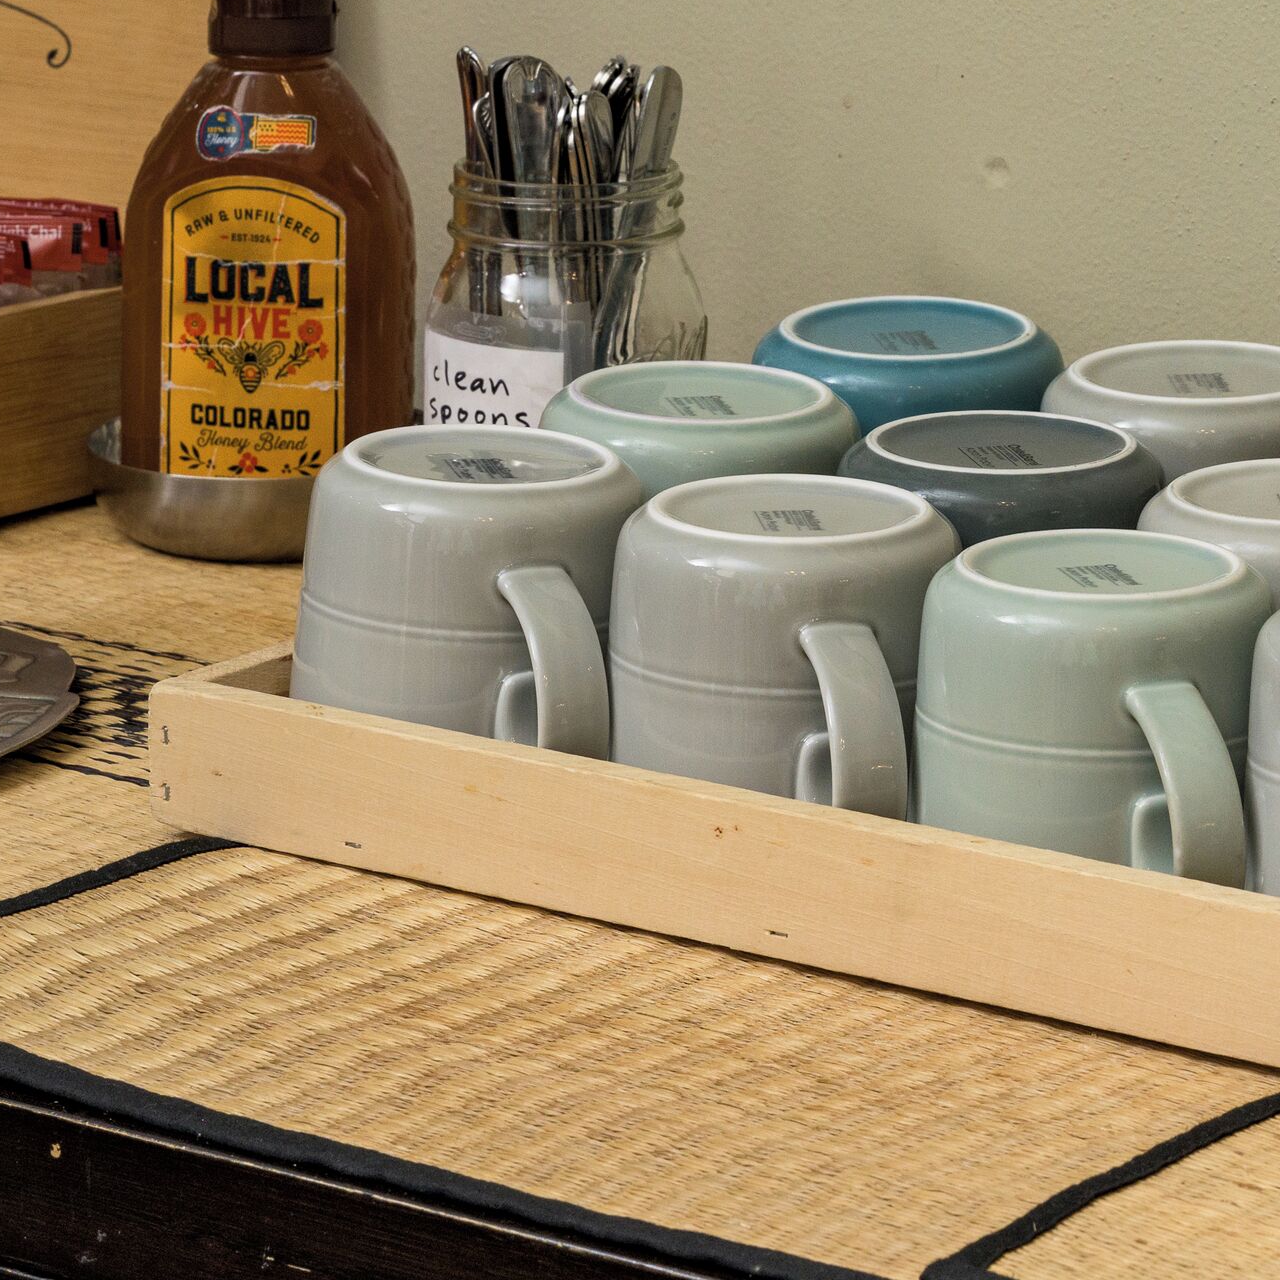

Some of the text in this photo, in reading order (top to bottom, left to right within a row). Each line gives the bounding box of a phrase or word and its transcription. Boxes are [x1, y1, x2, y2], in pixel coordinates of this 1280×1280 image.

[28, 224, 63, 240] Chai
[184, 208, 321, 245] RAW & UNFILTERED
[185, 256, 324, 309] LOCAL
[213, 304, 292, 341] HIVE
[433, 359, 511, 397] clean
[191, 403, 311, 431] COLORADO
[197, 428, 309, 454] Honey Blend
